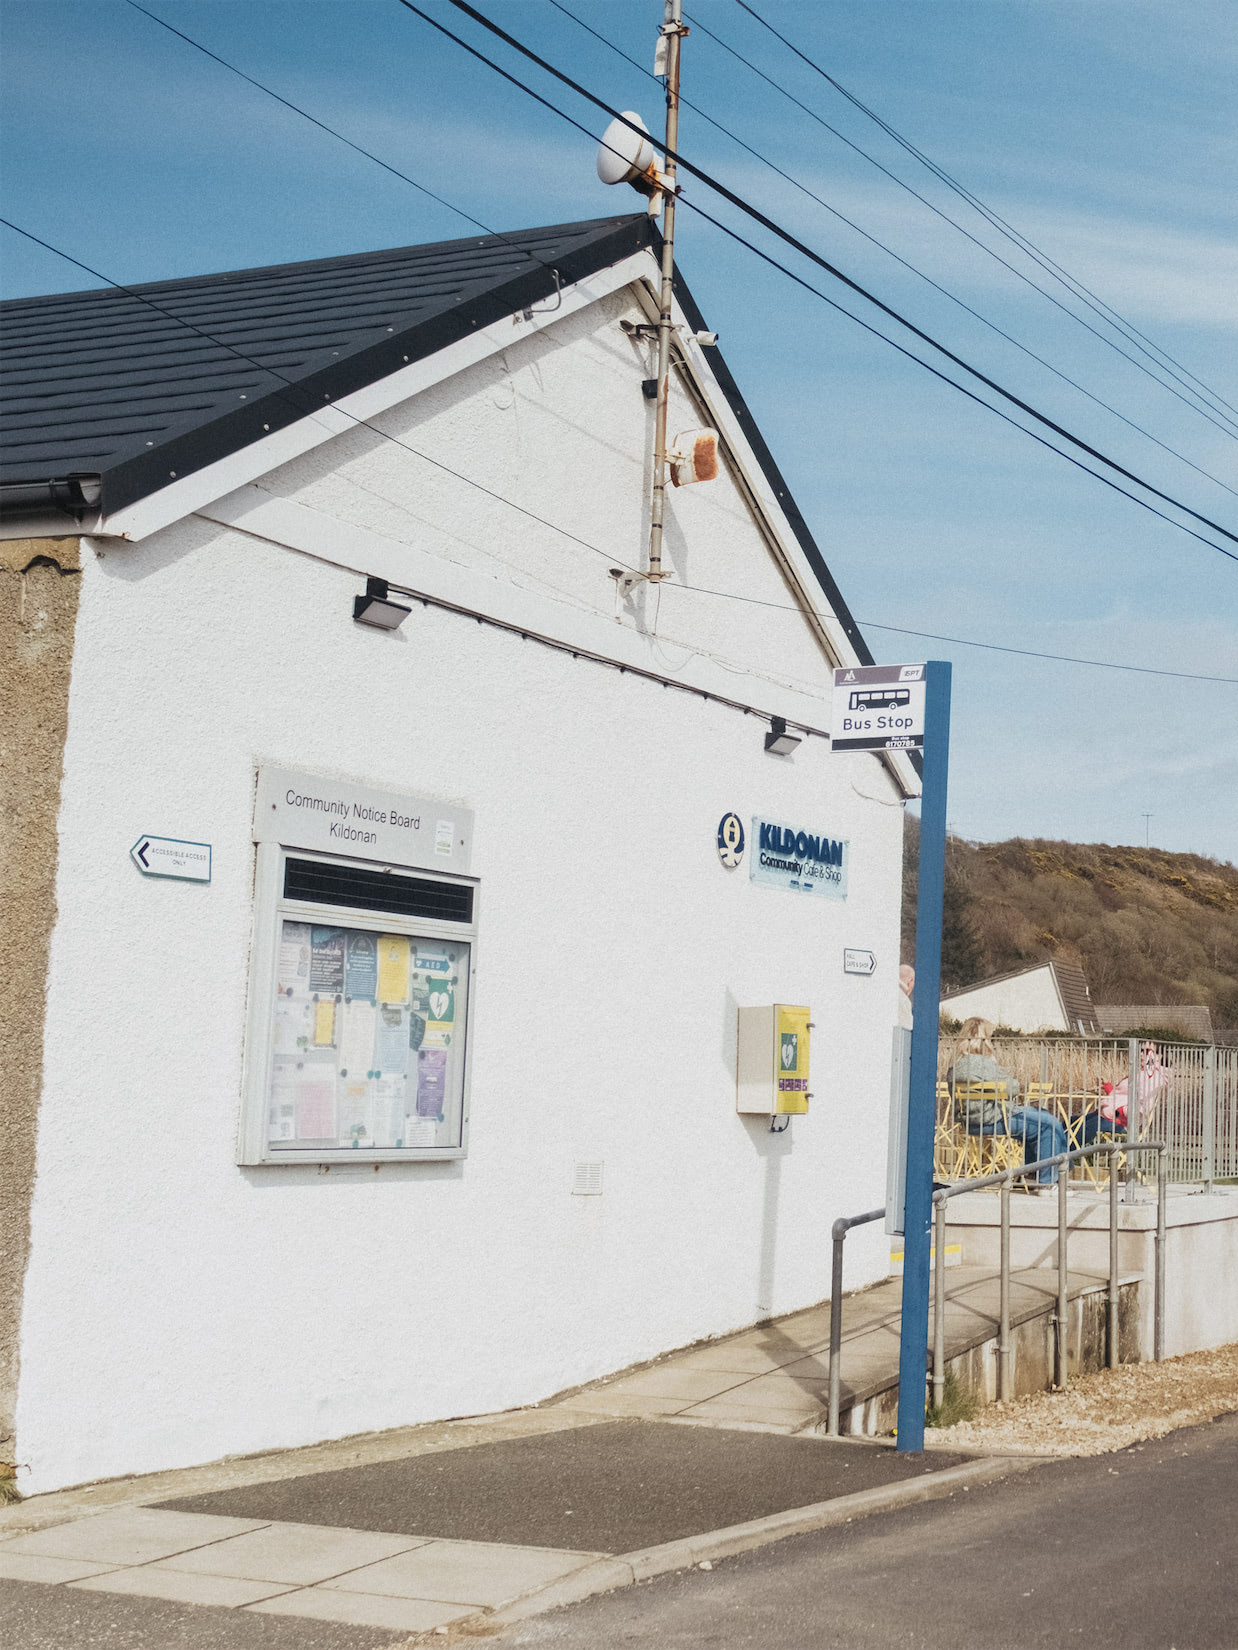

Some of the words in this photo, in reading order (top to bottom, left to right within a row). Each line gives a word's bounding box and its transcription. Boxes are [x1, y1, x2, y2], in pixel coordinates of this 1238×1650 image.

[843, 718, 871, 730] Bus
[877, 716, 913, 729] Stop
[286, 789, 350, 820] Community
[353, 803, 387, 823] Notice
[390, 811, 421, 830] Board
[329, 822, 377, 844] Kildonan
[760, 822, 843, 867] KILDONAN
[185, 851, 207, 861] ACCESS
[760, 852, 803, 877] Community
[820, 865, 825, 879] &
[825, 866, 842, 882] Shop
[425, 960, 441, 969] AED
